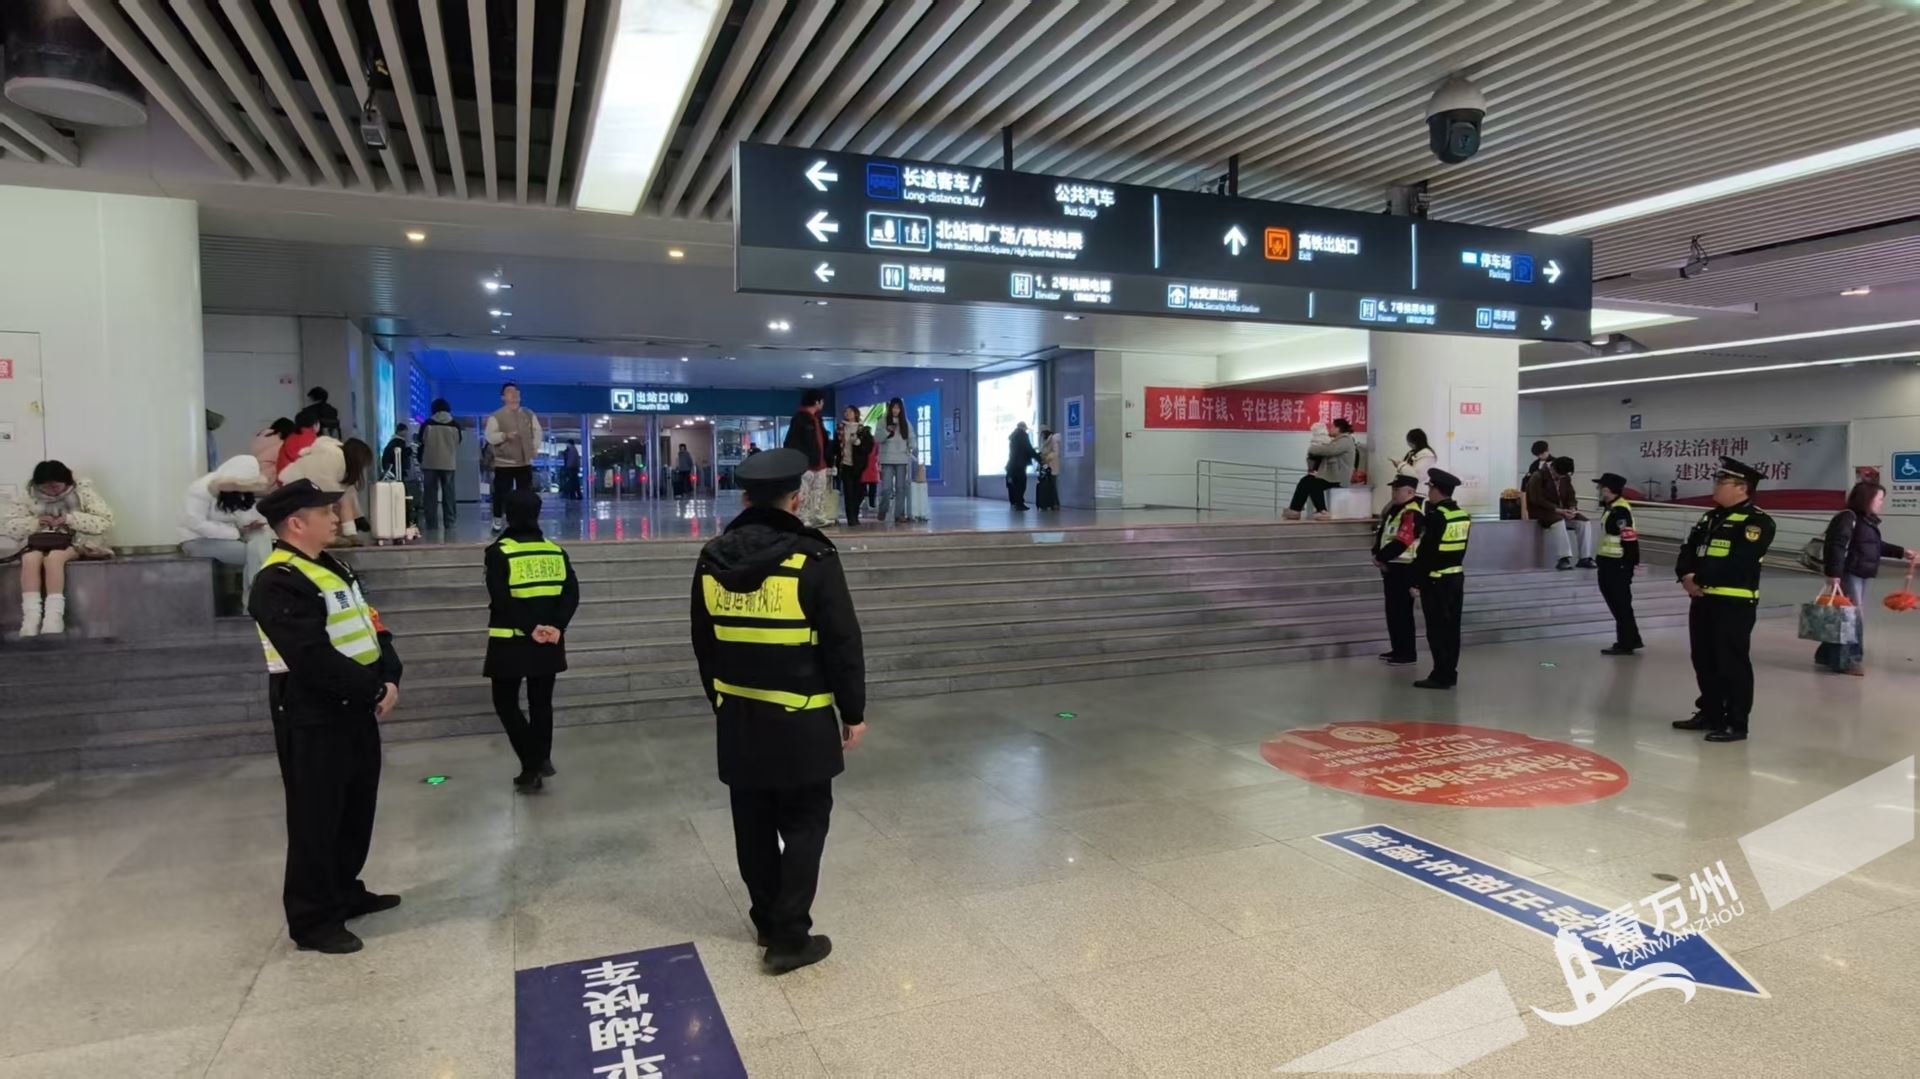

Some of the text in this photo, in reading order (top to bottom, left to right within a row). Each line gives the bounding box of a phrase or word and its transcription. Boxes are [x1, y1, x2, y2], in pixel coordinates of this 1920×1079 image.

[903, 189, 963, 204] Long-distance
[1055, 184, 1116, 207] 公共汽车
[1063, 205, 1097, 219] Bus Stop
[974, 244, 991, 252] South
[991, 245, 1010, 255] Square
[1298, 232, 1359, 255] 高铁出站口
[1298, 250, 1312, 261] Exit
[1481, 252, 1511, 270] 停车场
[908, 265, 946, 283] 洗手间
[1489, 269, 1511, 281] Parking
[908, 283, 946, 293] Restrooms
[1188, 301, 1204, 310] Public
[1639, 436, 1749, 458] 弘扬法治精神
[1674, 460, 1792, 481] 建设政府
[581, 961, 669, 1079] 平湖快车
